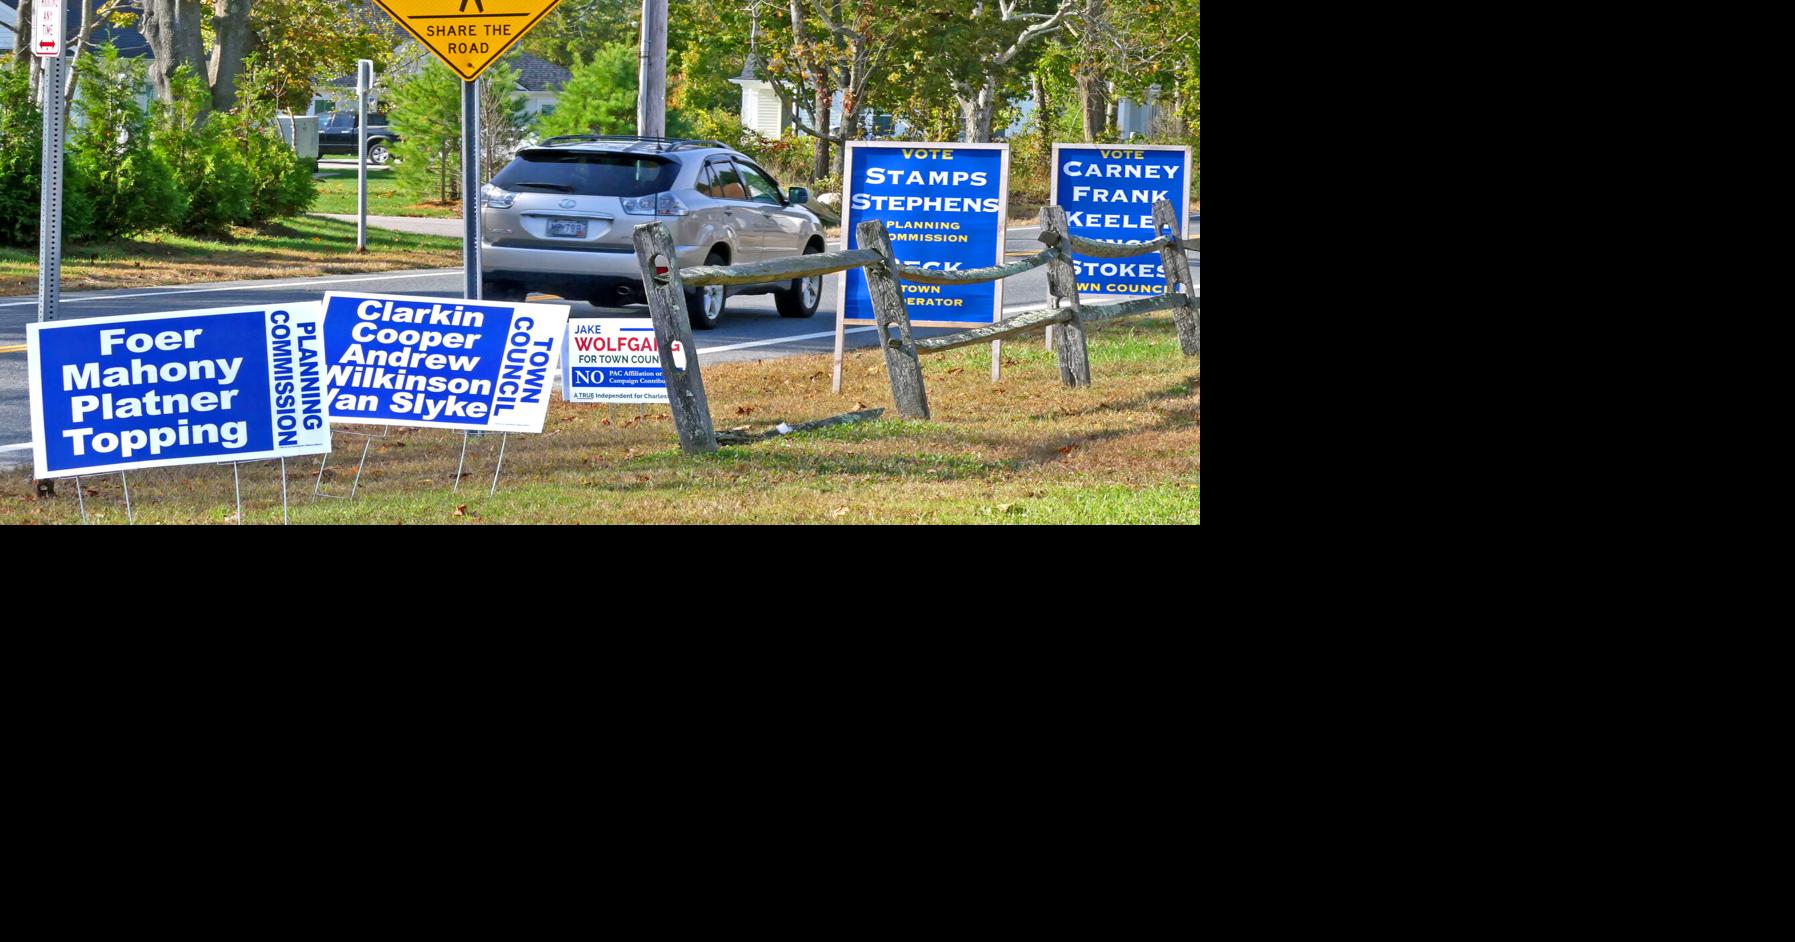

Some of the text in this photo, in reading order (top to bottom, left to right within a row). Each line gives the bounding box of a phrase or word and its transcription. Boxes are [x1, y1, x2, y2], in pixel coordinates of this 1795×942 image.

[426, 25, 511, 37] SHARE THE
[448, 43, 489, 54] ROAD
[902, 149, 954, 160] VOTE
[1100, 149, 1144, 160] VOTE
[865, 167, 988, 187] STAMPS
[1063, 161, 1179, 179] CARNEY
[851, 193, 999, 213] STEPHENS
[1073, 186, 1169, 203] FRANK
[886, 221, 961, 230] PLANNING
[1067, 211, 1170, 229] KEELE
[888, 233, 968, 243] OMMISSION
[901, 285, 941, 294] TOWN
[1076, 282, 1169, 294] WN COUNCI
[904, 297, 964, 307] ERATOR
[356, 300, 484, 327] Clarkin
[351, 321, 481, 351] Cooper
[574, 325, 602, 334] JAKE
[100, 328, 204, 356] Foer
[338, 343, 481, 372] Andrew
[493, 316, 534, 417] COUNCIL
[578, 355, 660, 364] FOR TOWN COUN
[62, 357, 244, 392] Mahony
[269, 309, 298, 447] COMMISSION
[296, 321, 324, 431] PLANNING
[519, 336, 554, 404] TOWN
[575, 370, 605, 384] NO
[327, 364, 492, 396] Wilkinson
[71, 389, 240, 423] Platner
[389, 392, 488, 421] Slyke
[62, 420, 248, 458] Topping
